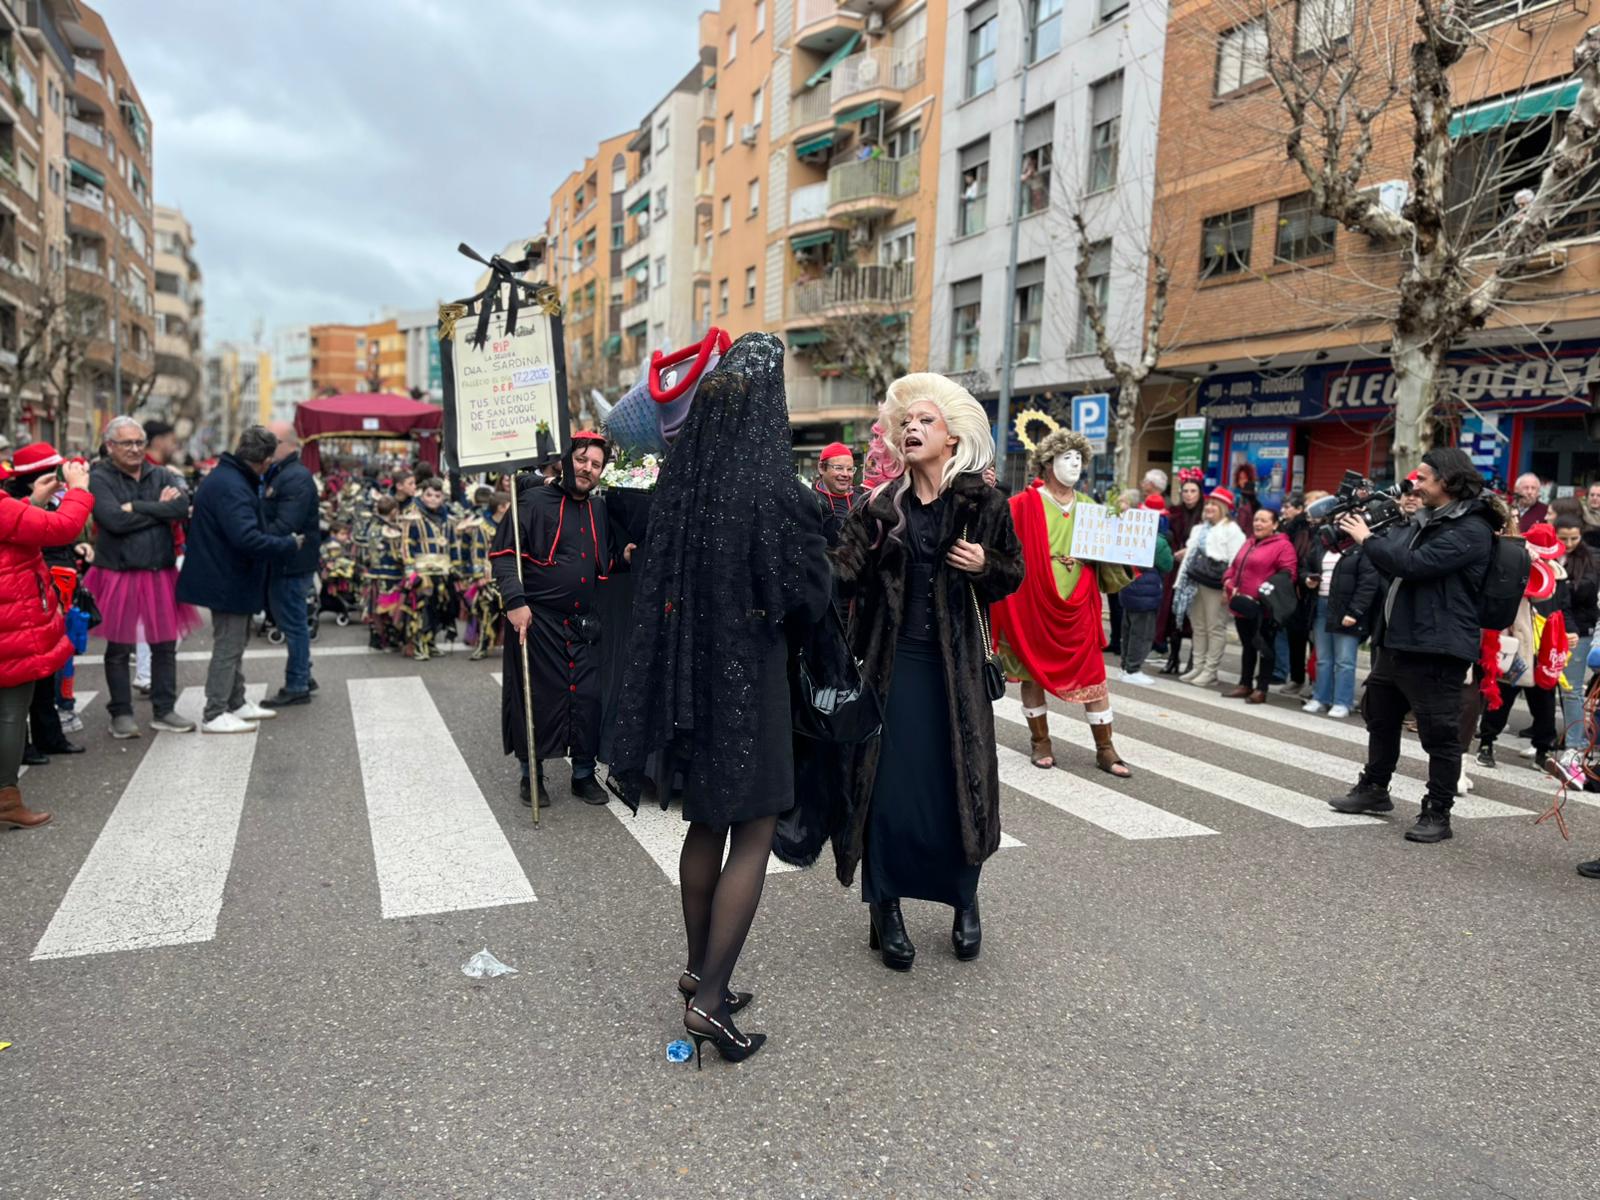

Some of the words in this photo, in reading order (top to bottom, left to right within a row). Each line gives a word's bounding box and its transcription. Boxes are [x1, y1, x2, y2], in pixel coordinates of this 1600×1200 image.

[1328, 357, 1600, 408] ELECROCAS
[470, 398, 489, 409] TUS
[494, 391, 537, 406] VECINOS
[470, 411, 484, 421] DE
[487, 408, 506, 418] SAN
[507, 403, 535, 415] ROQUE
[1079, 401, 1100, 437] P
[471, 422, 482, 432] NO
[485, 419, 497, 430] TE
[499, 415, 537, 428] OLVIDAN
